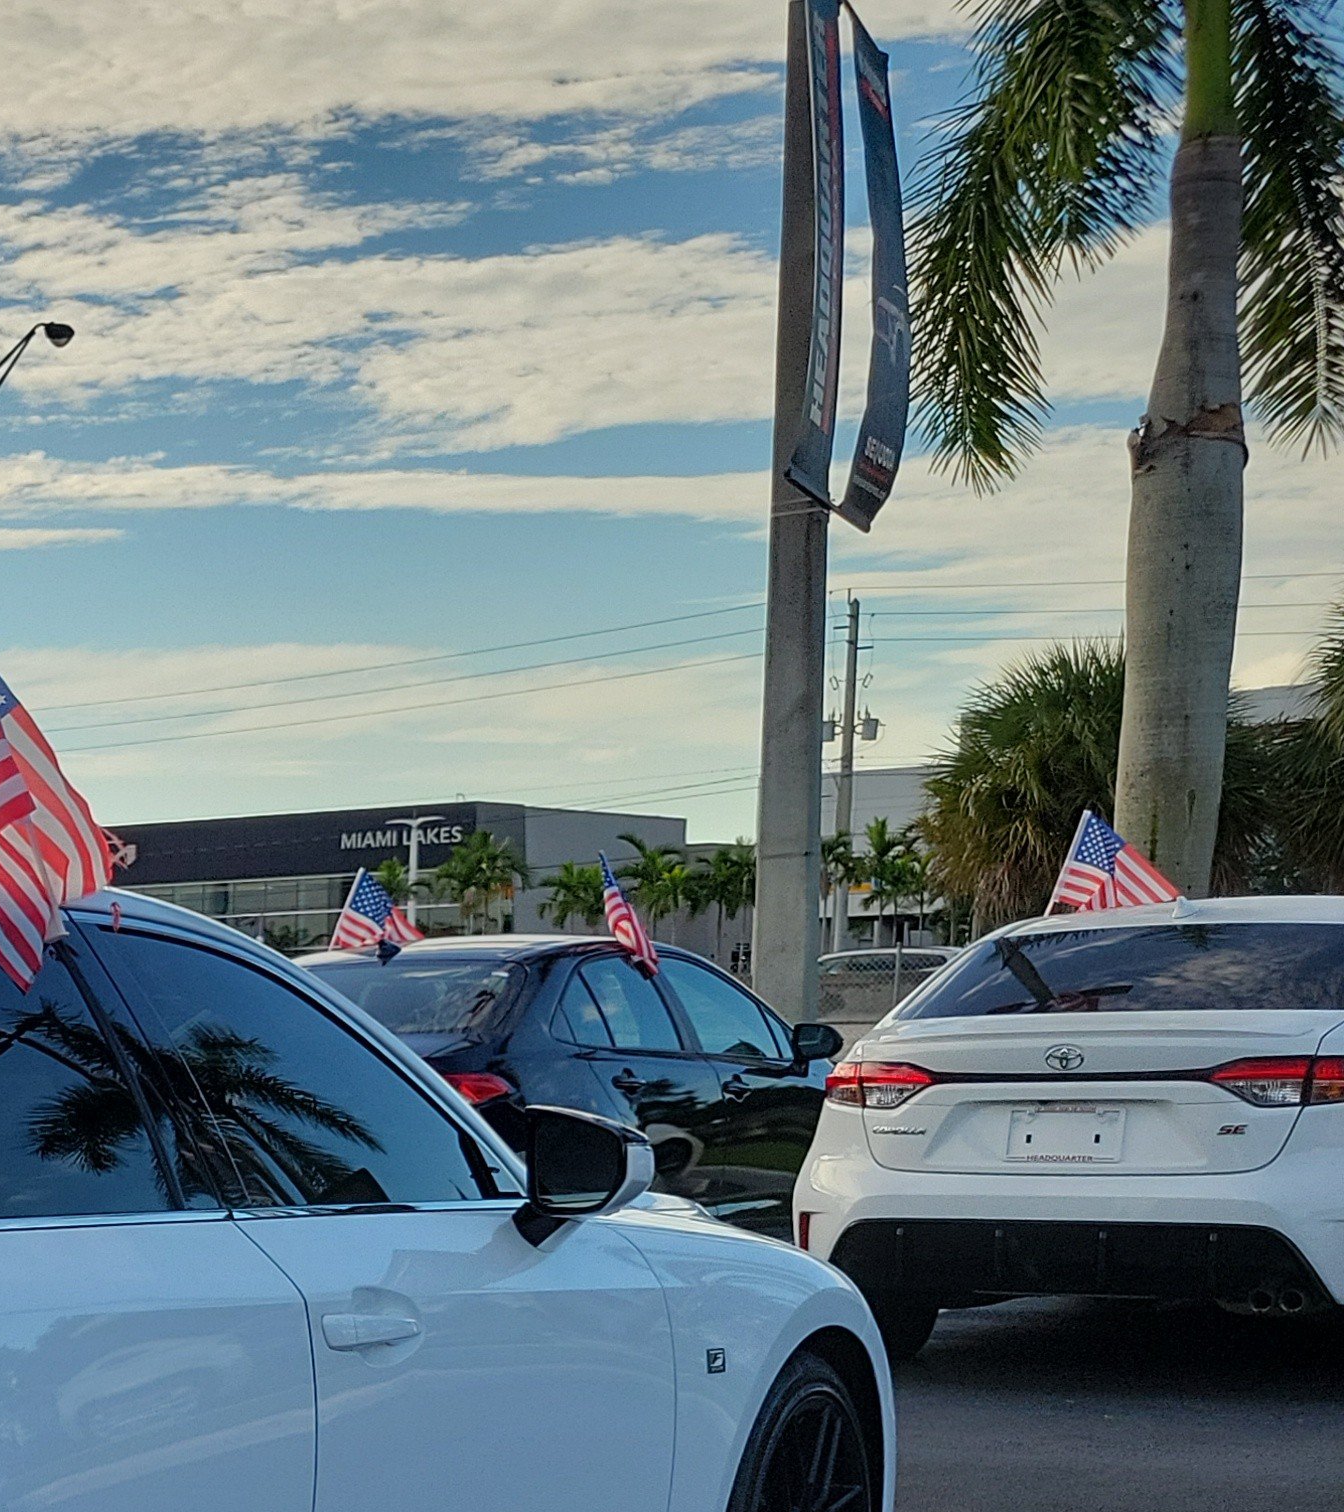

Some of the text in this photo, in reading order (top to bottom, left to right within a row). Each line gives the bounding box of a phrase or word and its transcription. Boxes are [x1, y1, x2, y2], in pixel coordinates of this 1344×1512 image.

[340, 826, 463, 849] MIAMI LAKES
[1217, 1124, 1248, 1135] SE
